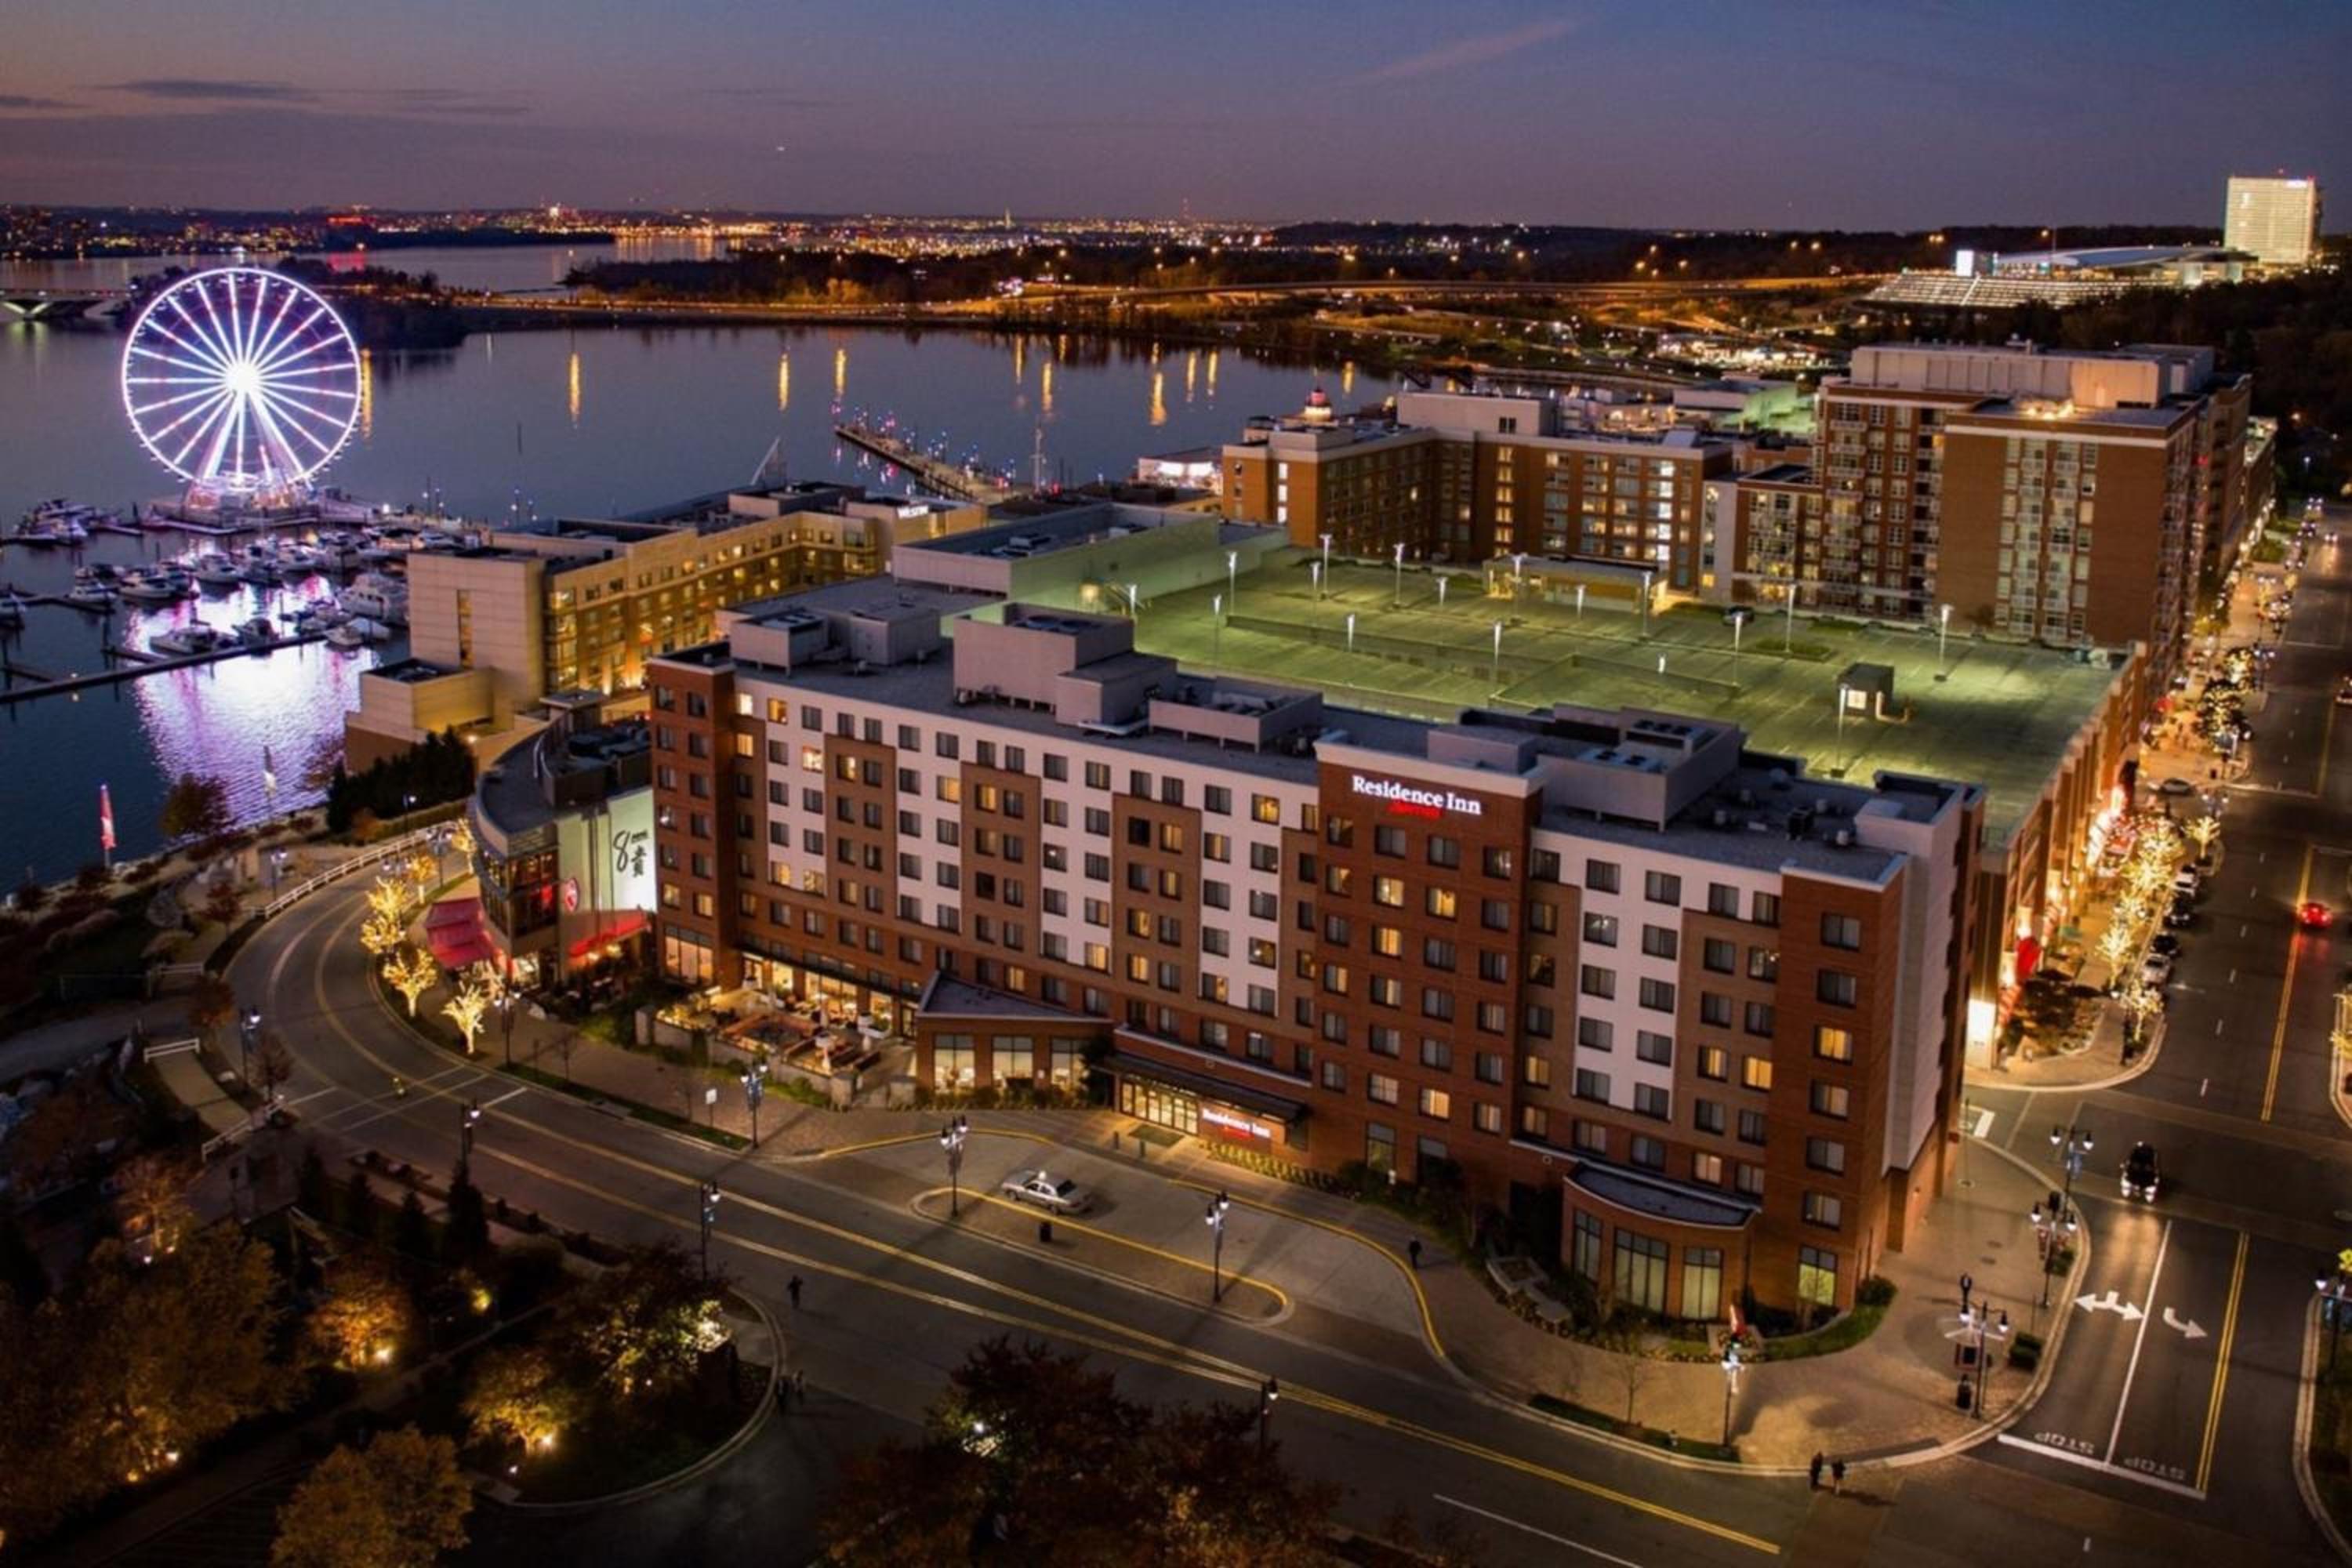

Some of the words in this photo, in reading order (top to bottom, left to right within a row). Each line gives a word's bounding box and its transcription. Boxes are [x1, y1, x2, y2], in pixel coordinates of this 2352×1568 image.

[1352, 775, 1444, 808] Residence
[1446, 791, 1482, 815] Inn
[2034, 1431, 2095, 1455] STOP
[2123, 1456, 2186, 1480] STOP
